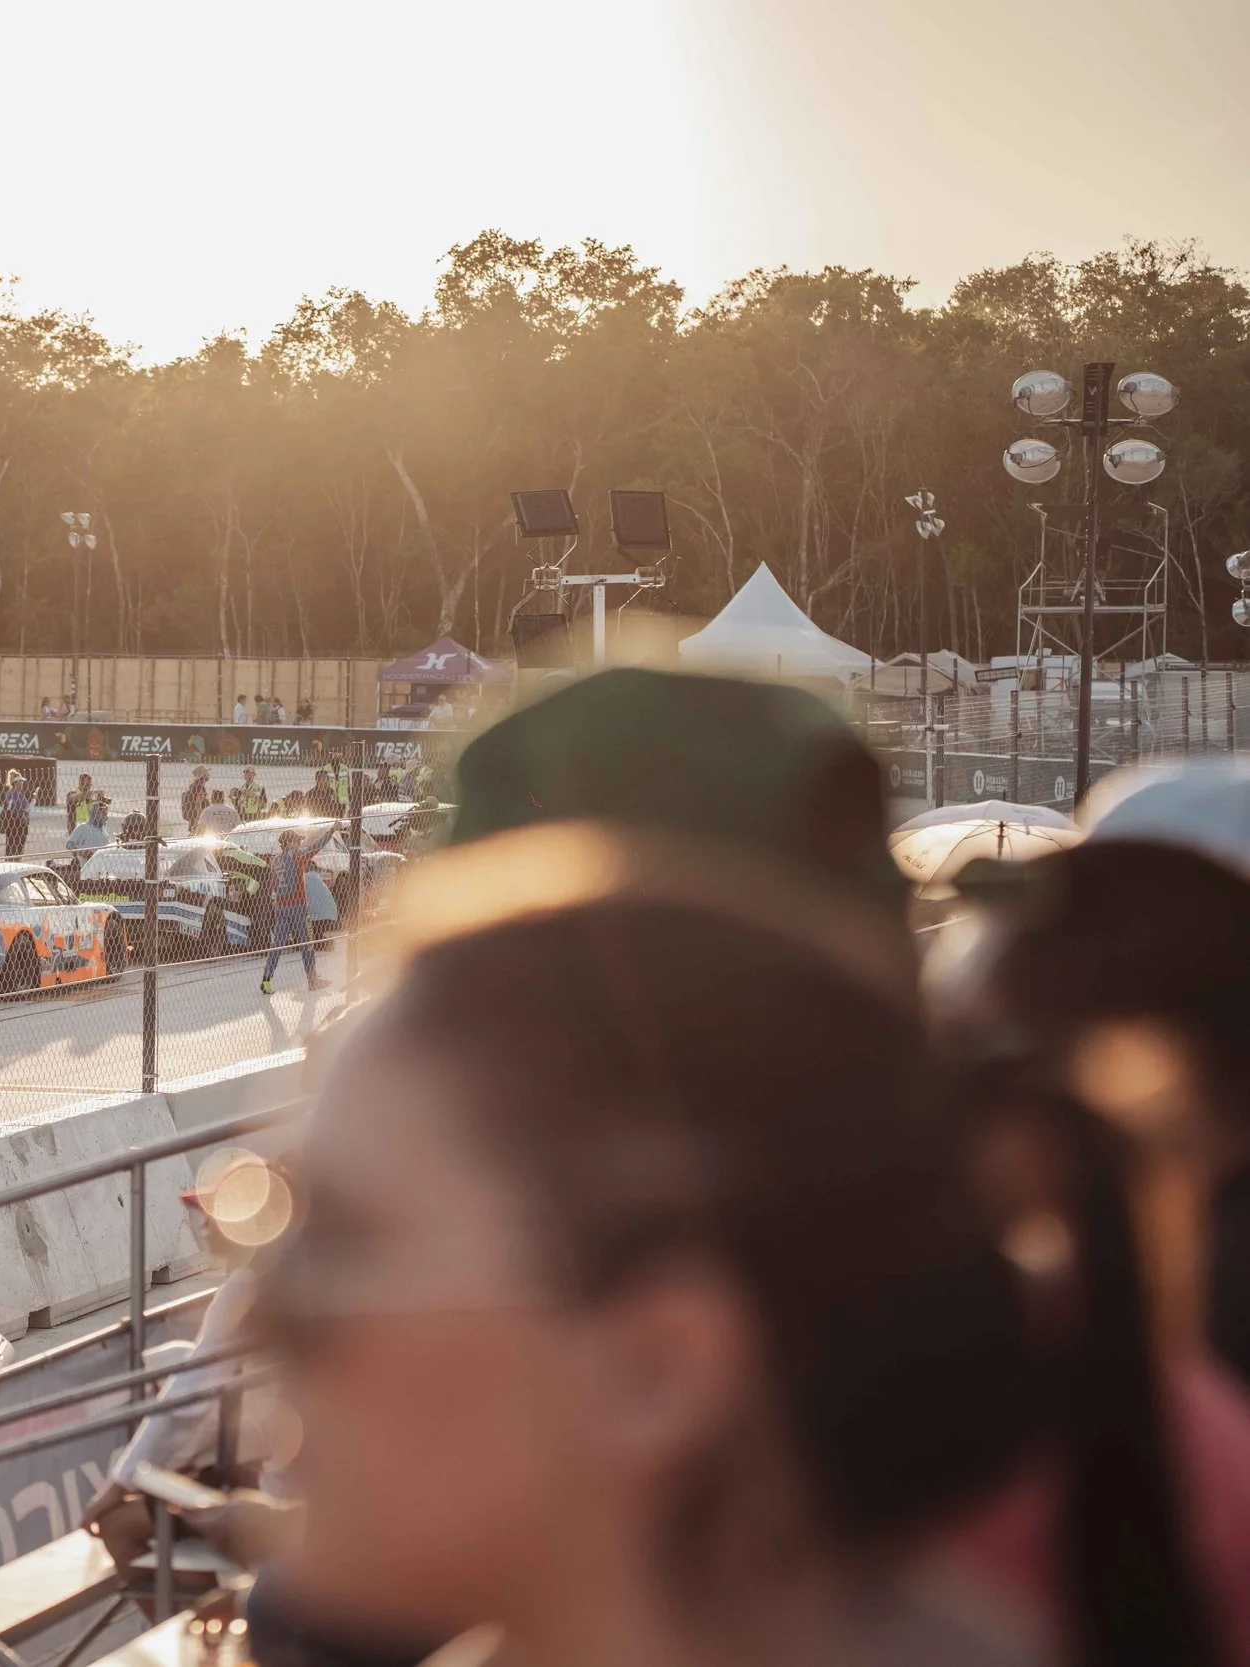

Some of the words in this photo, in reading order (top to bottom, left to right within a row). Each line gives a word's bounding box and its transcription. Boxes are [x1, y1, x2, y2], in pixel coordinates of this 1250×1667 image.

[121, 735, 171, 752] TRESA
[251, 739, 300, 756] TRESA
[376, 741, 422, 758] TRESA
